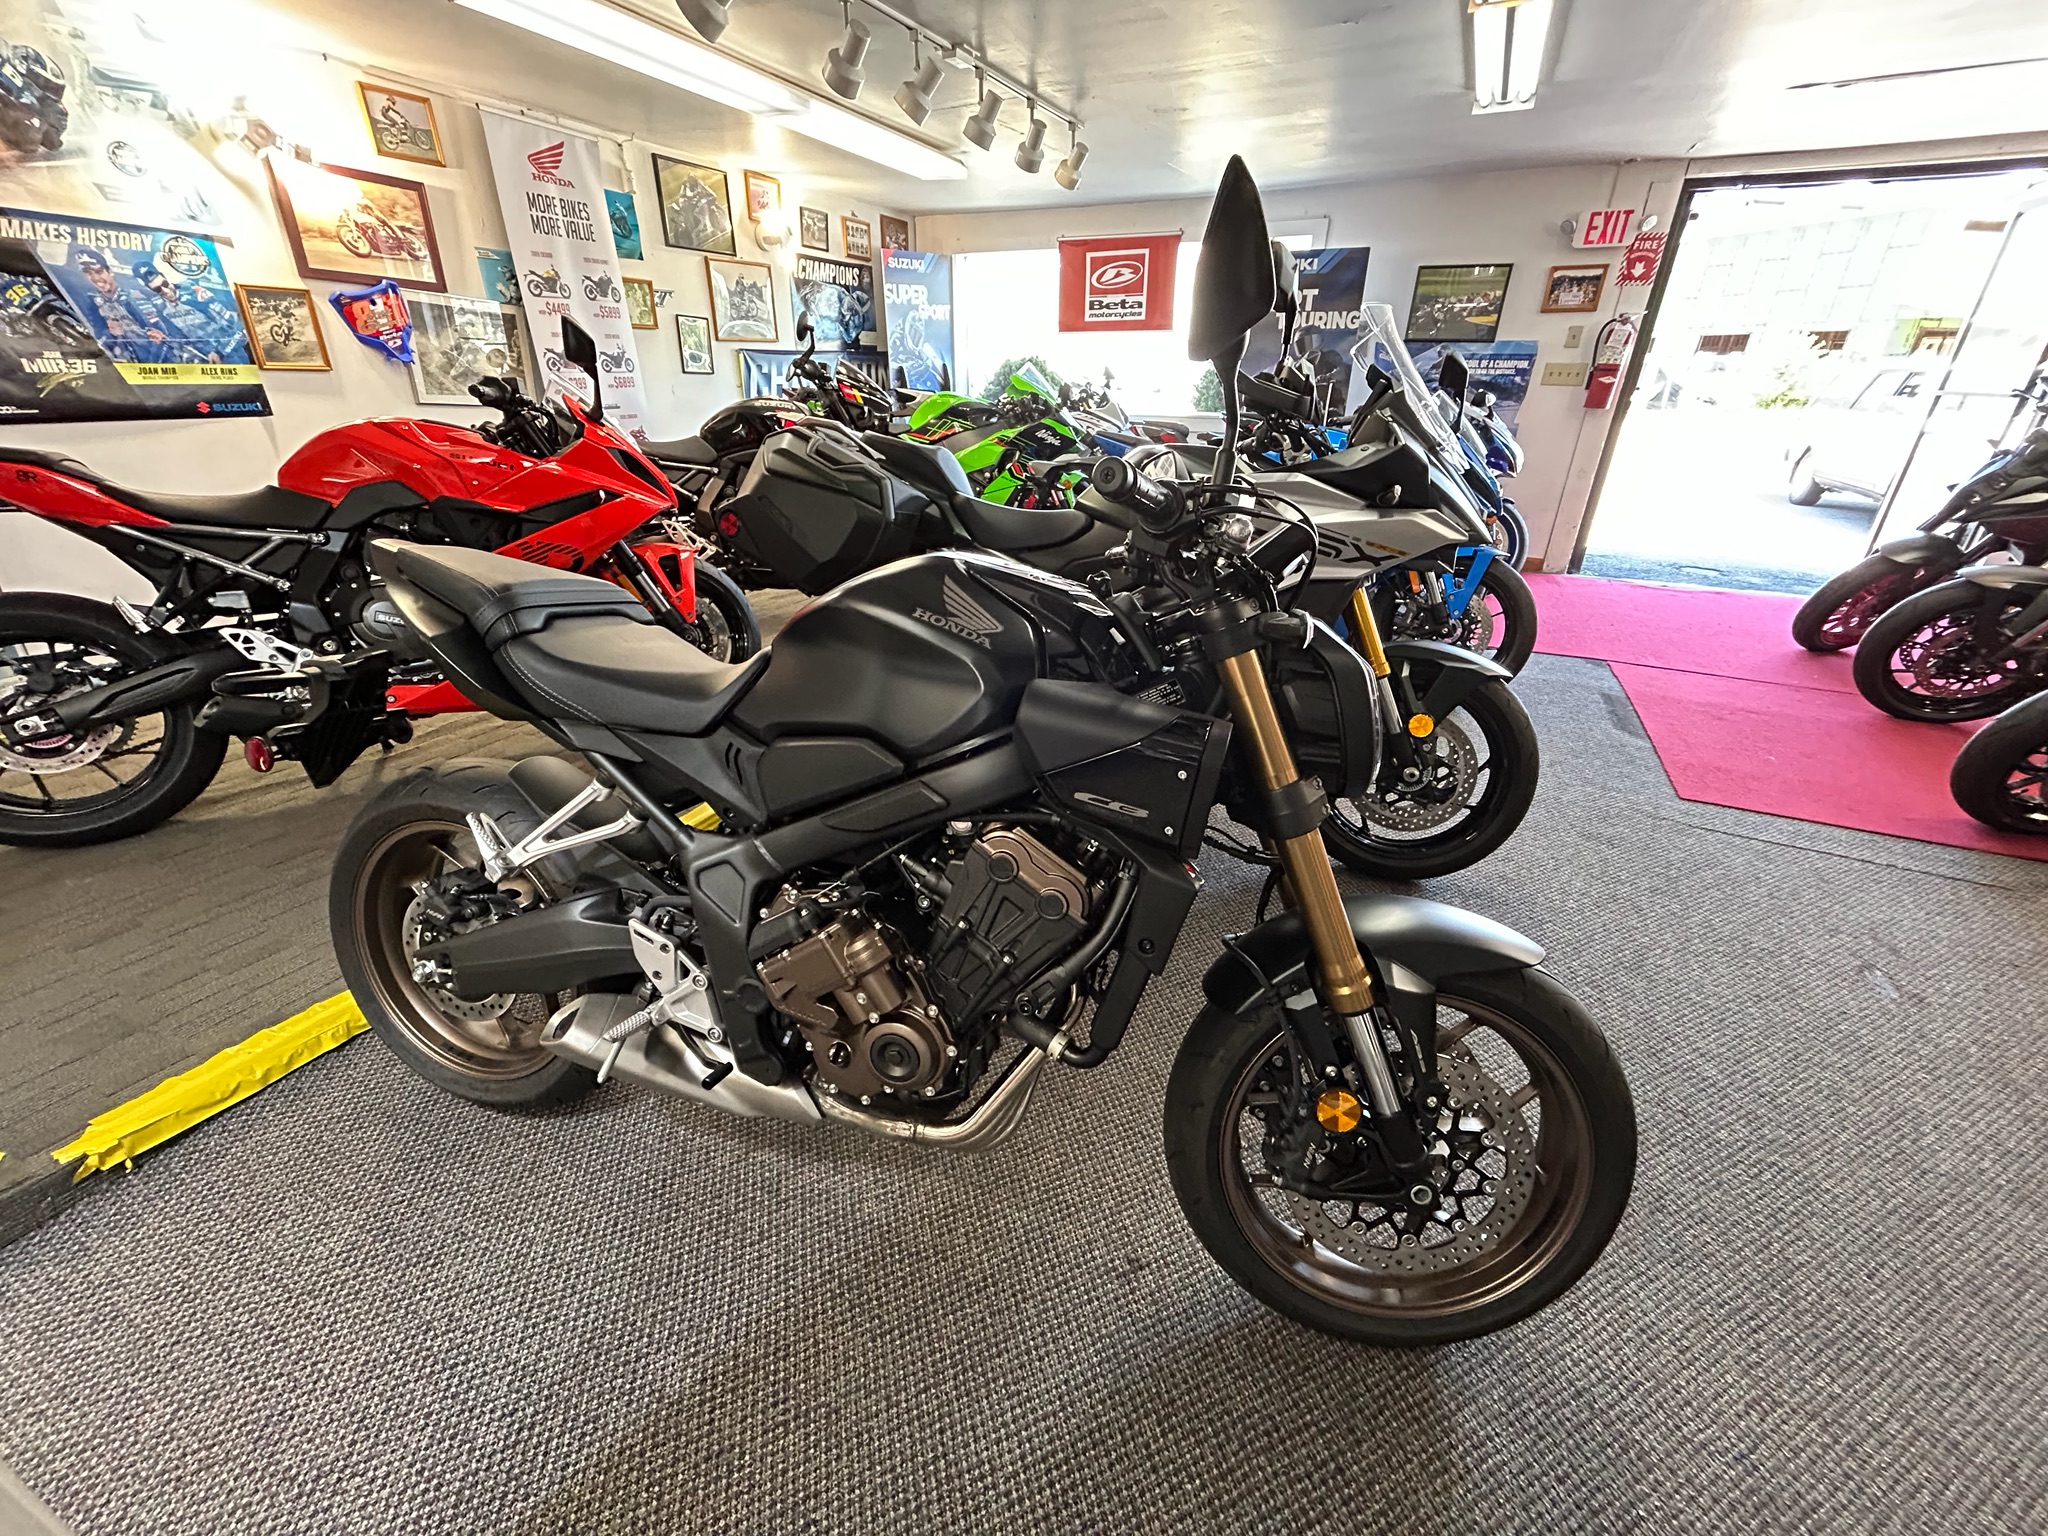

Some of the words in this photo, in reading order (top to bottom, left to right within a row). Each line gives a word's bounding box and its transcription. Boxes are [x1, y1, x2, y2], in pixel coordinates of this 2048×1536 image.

[531, 172, 575, 189] HONDA
[526, 191, 559, 216] MORE
[559, 197, 591, 221] BIKES
[0, 218, 72, 244] MAKES
[76, 226, 153, 252] HISTORY
[530, 213, 563, 237] MORE
[562, 219, 596, 242] VALUE
[1583, 209, 1635, 245] EXIT
[1632, 240, 1660, 250] FIRE
[887, 257, 925, 270] SUZUKI
[798, 258, 860, 287] CHAMPIONS
[885, 283, 929, 305] SUPER
[918, 304, 951, 321] SPORT
[1088, 299, 1143, 311] Beta
[1088, 310, 1142, 319] motorcycles
[138, 366, 159, 375] JOAN
[160, 366, 177, 375] MIR
[201, 367, 218, 375] ALEX
[212, 402, 263, 411] SUZUKI
[1034, 429, 1061, 446] Ninja
[912, 607, 992, 650] HONDA
